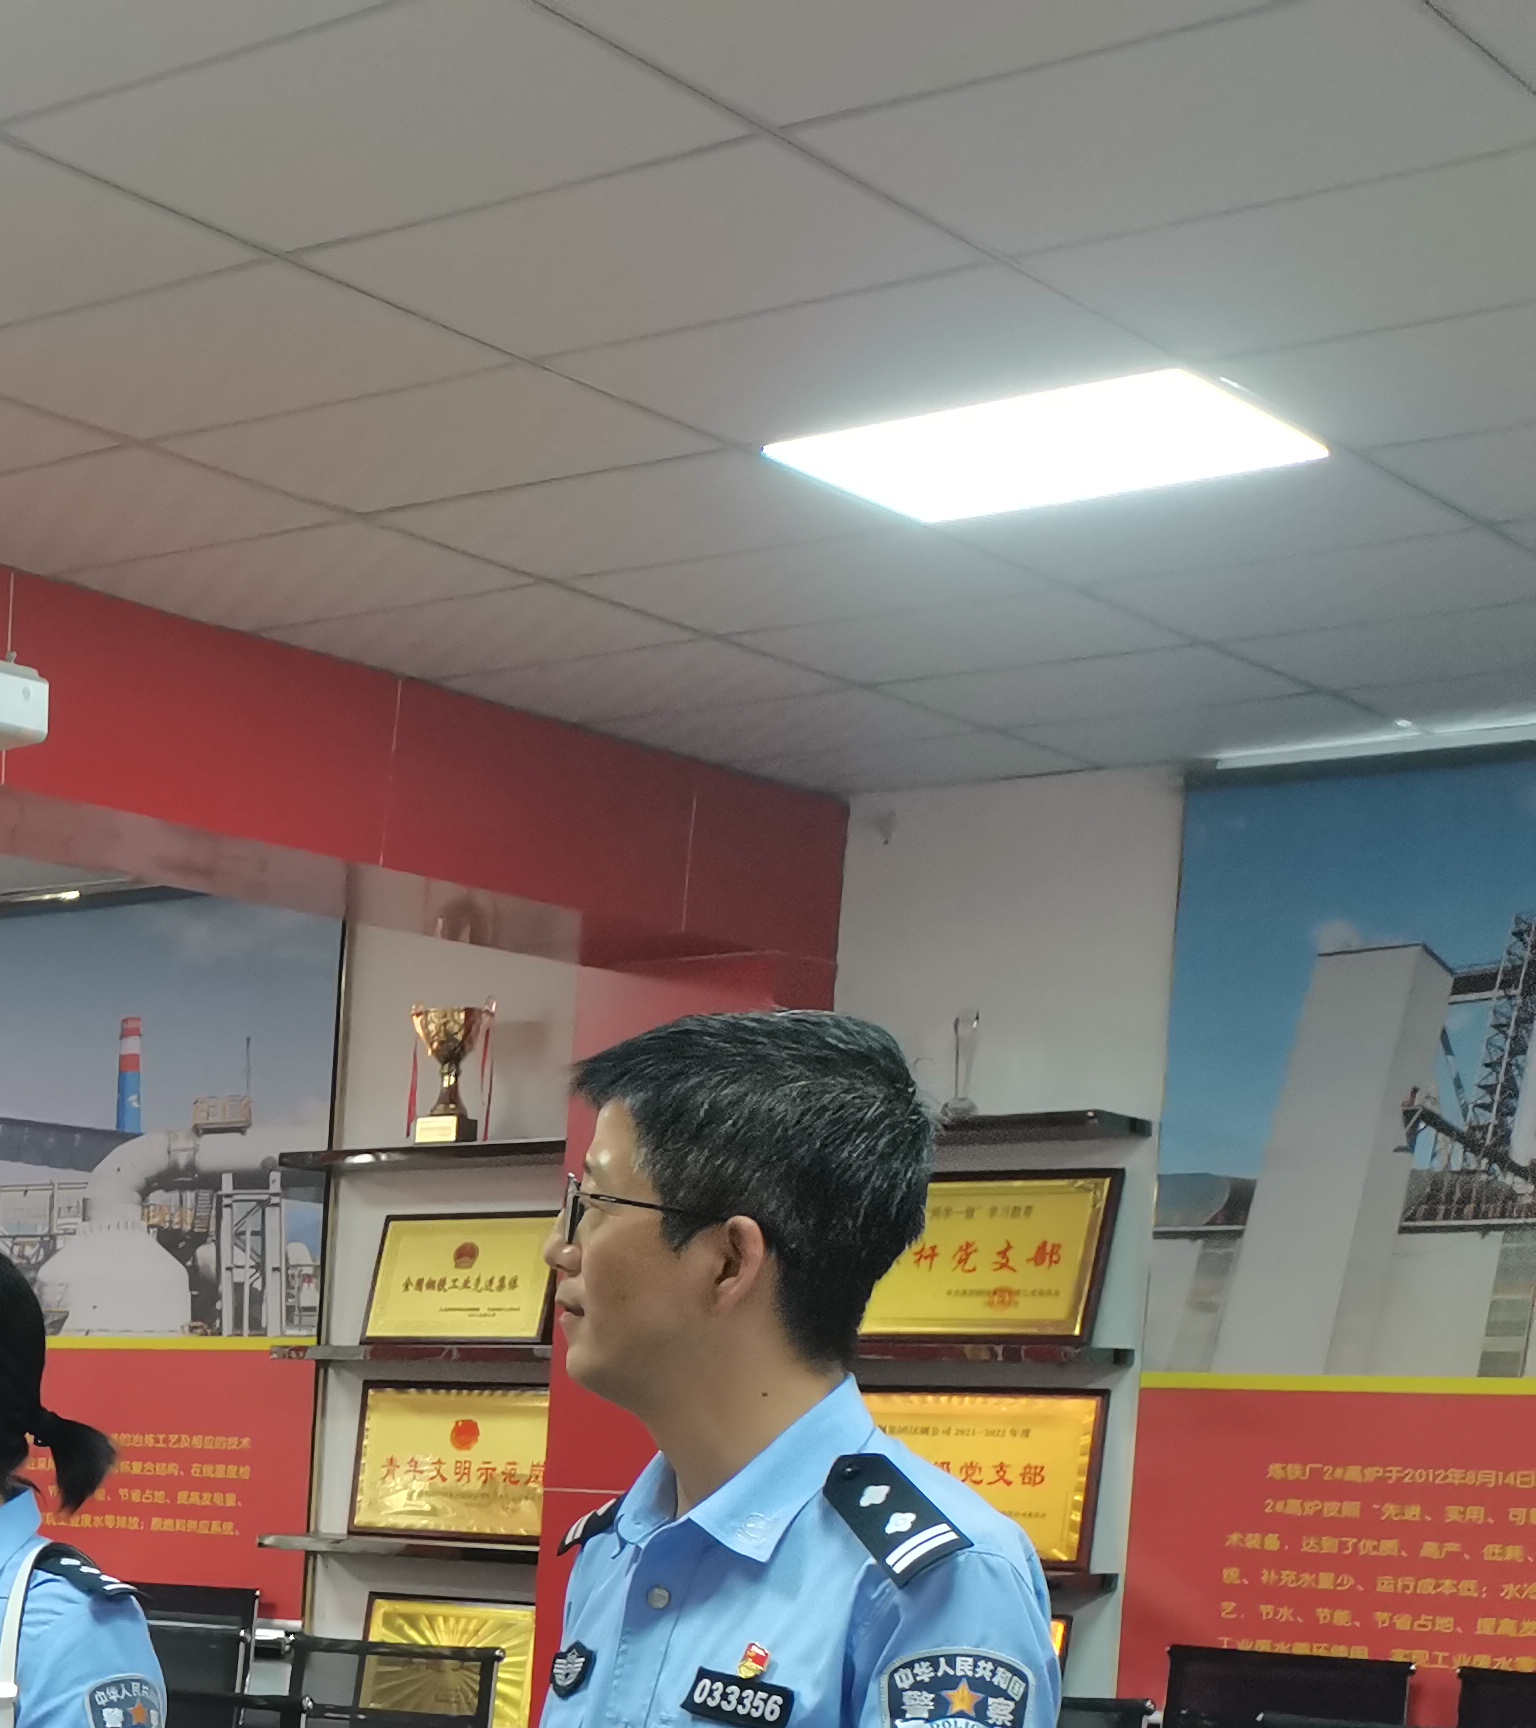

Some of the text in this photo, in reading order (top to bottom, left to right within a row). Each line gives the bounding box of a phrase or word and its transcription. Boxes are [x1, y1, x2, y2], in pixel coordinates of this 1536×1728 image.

[896, 1239, 1063, 1275] 杆党支部
[693, 1678, 783, 1722] 033356
[893, 1656, 1027, 1702] 中华人民共和国
